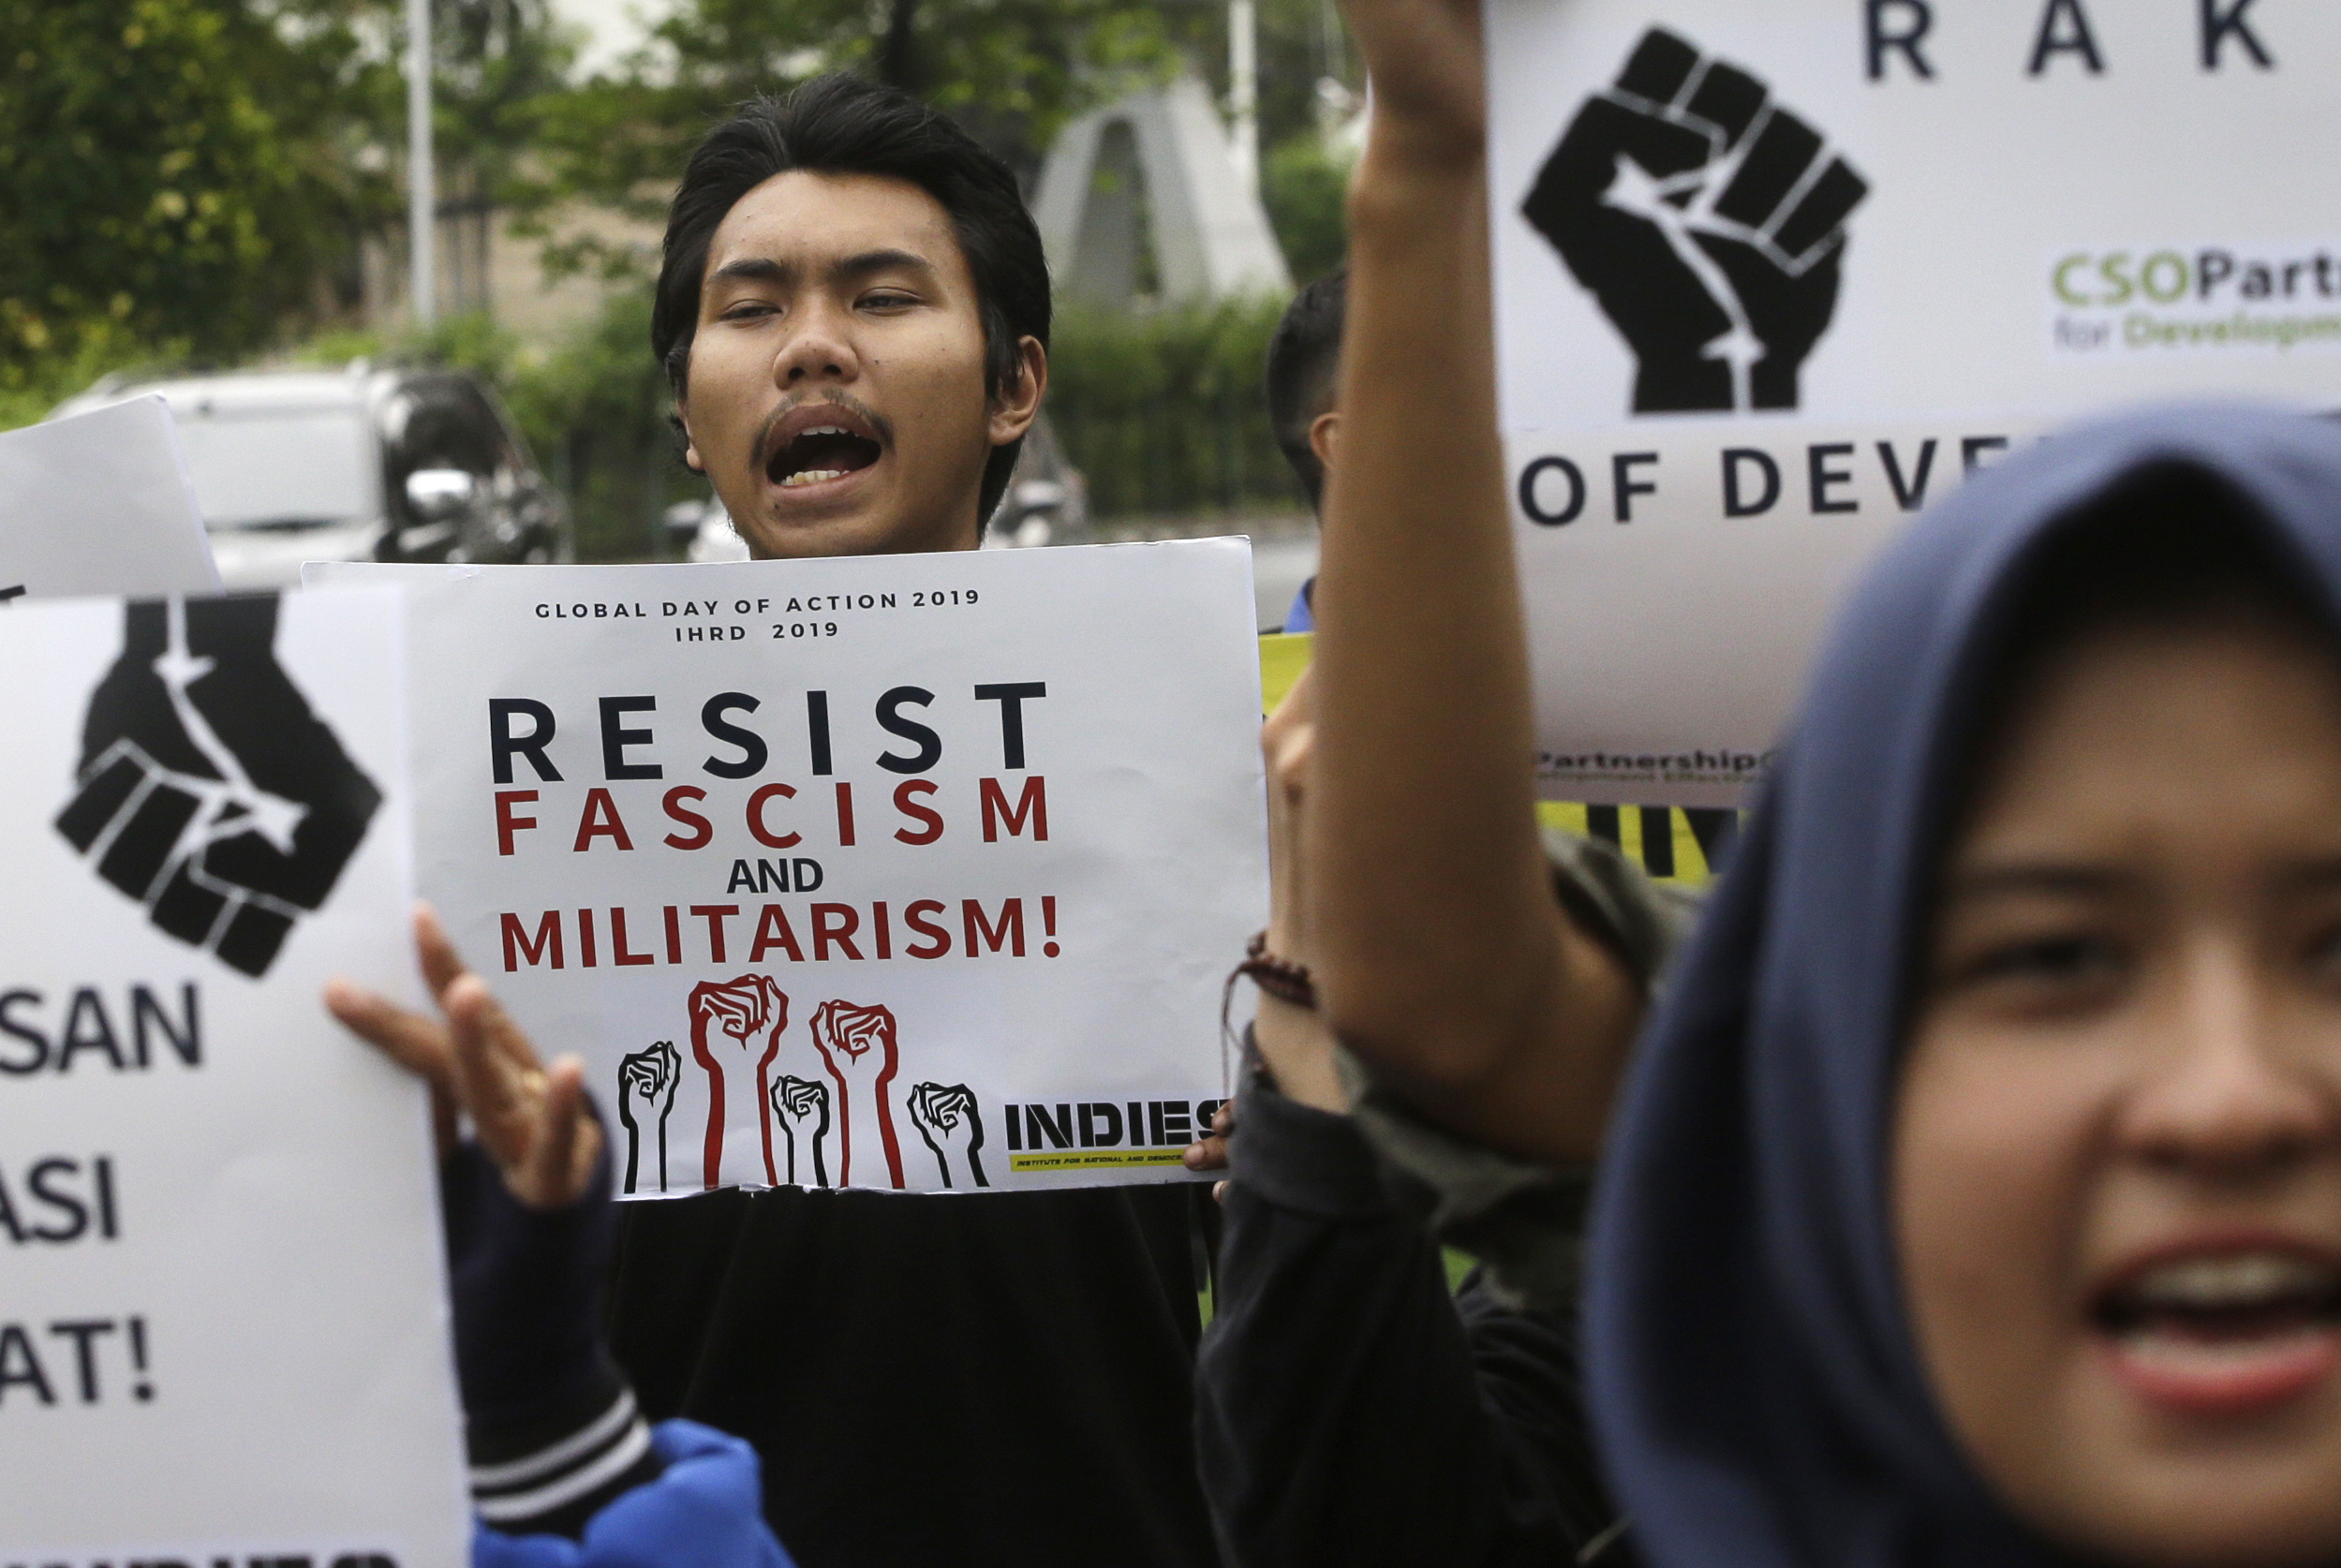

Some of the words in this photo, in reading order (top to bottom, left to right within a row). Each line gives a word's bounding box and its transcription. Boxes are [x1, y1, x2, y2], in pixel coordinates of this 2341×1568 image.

[2052, 249, 2341, 306] CSOPart
[1518, 451, 1659, 527] OF
[535, 601, 647, 620] GLOBAL
[662, 599, 719, 617] DAY
[734, 598, 771, 614] OF
[786, 592, 896, 614] ACTION
[911, 588, 981, 608] 2019
[675, 626, 748, 643] IHRD
[772, 621, 839, 640] 2019
[488, 681, 1046, 783] RESIST
[494, 776, 1048, 856] FASCISM
[727, 858, 824, 895] AND
[499, 895, 1061, 972] MILITARISM!
[1016, 1158, 1060, 1167] INSTITUTE
[1084, 1155, 1123, 1163] NATIONAL
